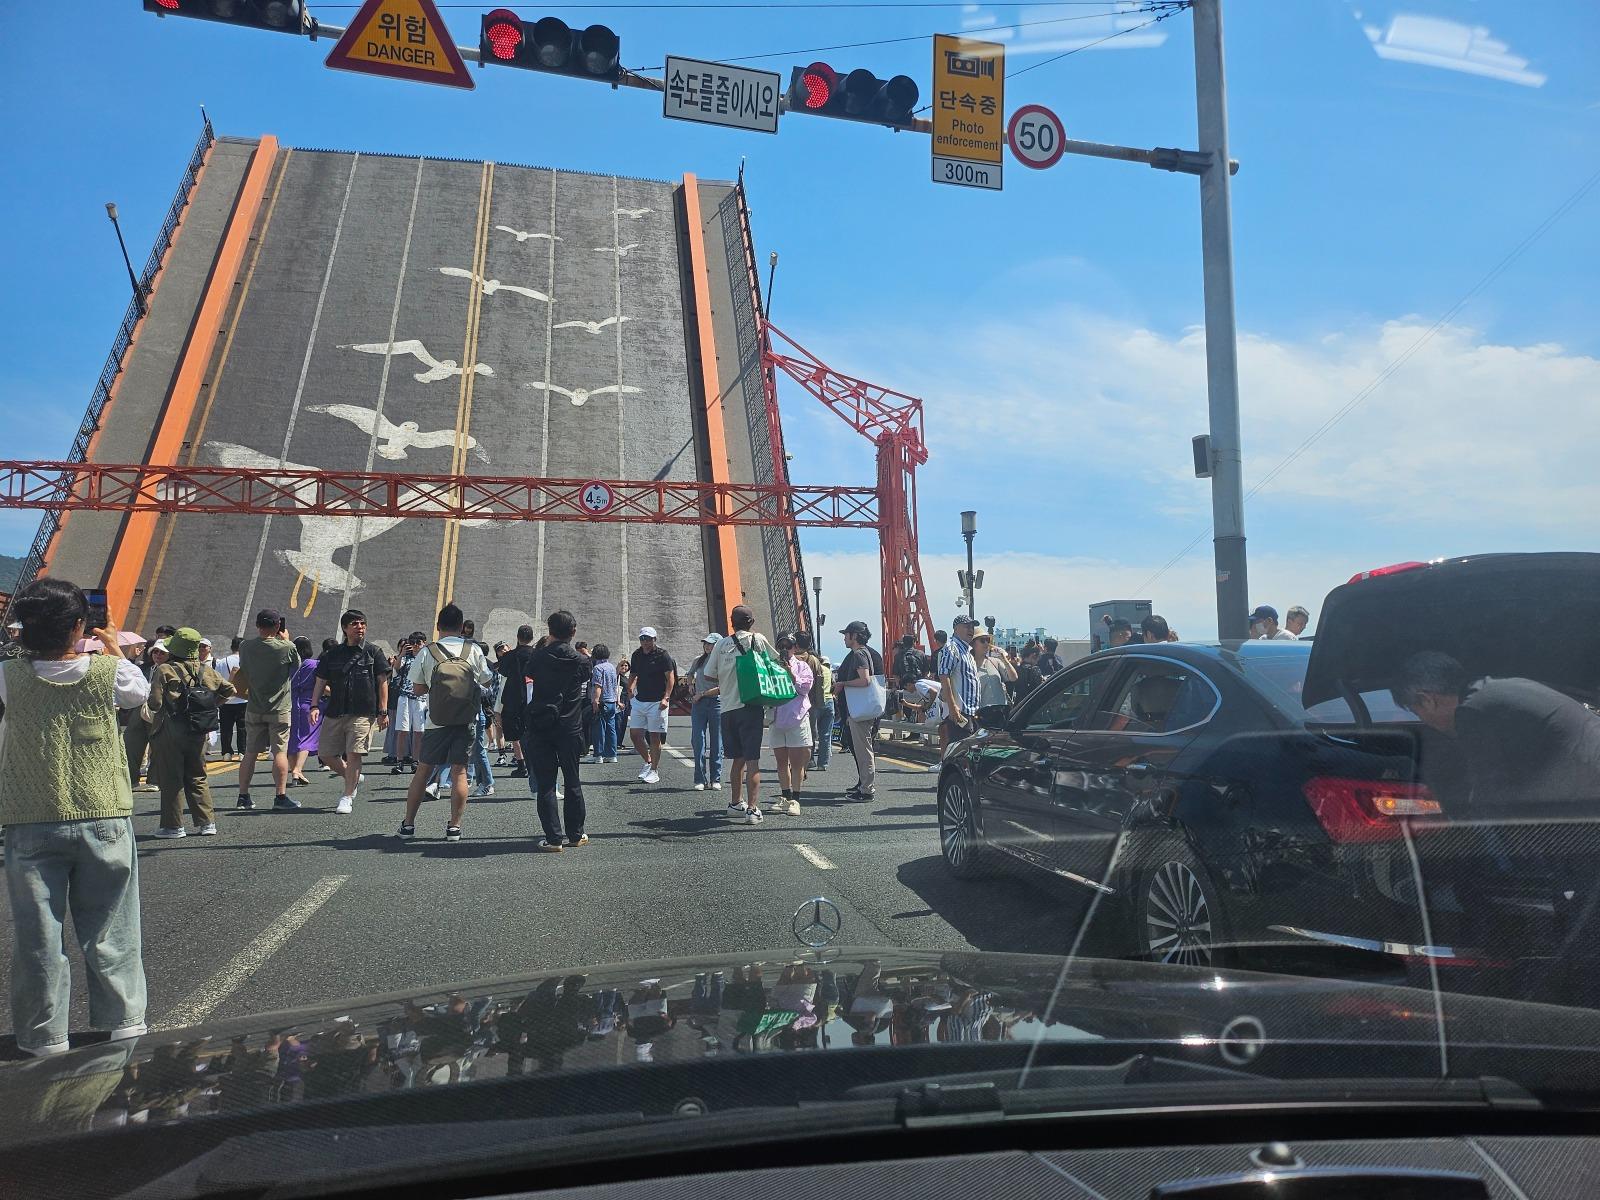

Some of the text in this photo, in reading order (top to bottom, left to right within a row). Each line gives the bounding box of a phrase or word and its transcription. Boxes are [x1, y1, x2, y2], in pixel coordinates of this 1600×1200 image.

[378, 13, 426, 45] 위험
[367, 41, 435, 66] DANGER
[940, 90, 996, 115] 단속중
[952, 119, 984, 134] Photo
[1019, 122, 1054, 152] 50
[936, 134, 999, 151] enforcement
[945, 162, 989, 184] 300m
[758, 672, 796, 696] EARTH
